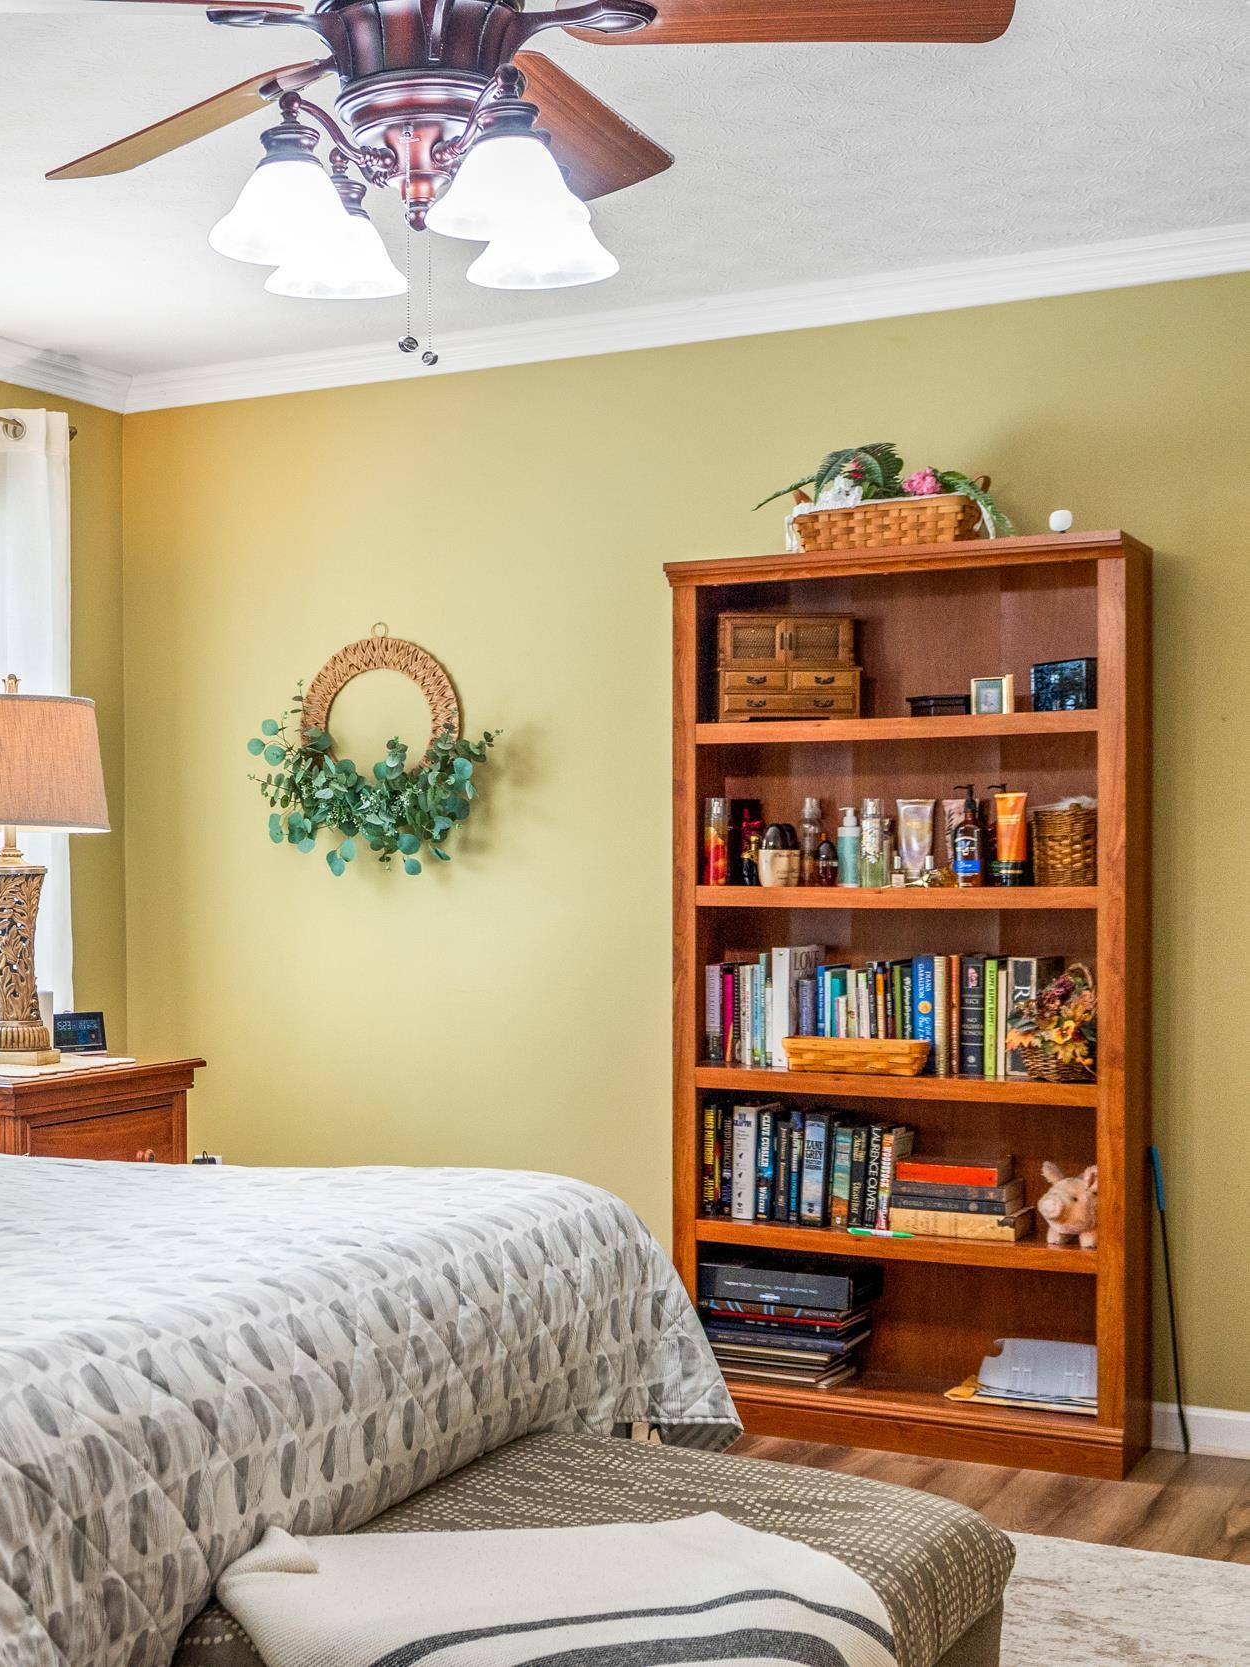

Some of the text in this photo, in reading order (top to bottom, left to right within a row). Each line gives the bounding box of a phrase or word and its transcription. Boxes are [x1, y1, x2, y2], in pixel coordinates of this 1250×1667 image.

[793, 950, 820, 971] LOVE
[917, 963, 925, 999] GABALDON
[924, 971, 932, 992] DIANA
[704, 1109, 714, 1129] JAMES
[723, 1119, 732, 1139] DAVID
[704, 1130, 714, 1165] PATTERSON
[759, 1113, 771, 1167] CLIVE CUSSLER
[806, 1140, 823, 1150] ZANE
[723, 1139, 732, 1168] BALDACCI
[805, 1150, 823, 1160] GREY
[865, 1126, 882, 1211] LAURENCE OLIVIER
[880, 1146, 892, 1188] WOODSTOCK
